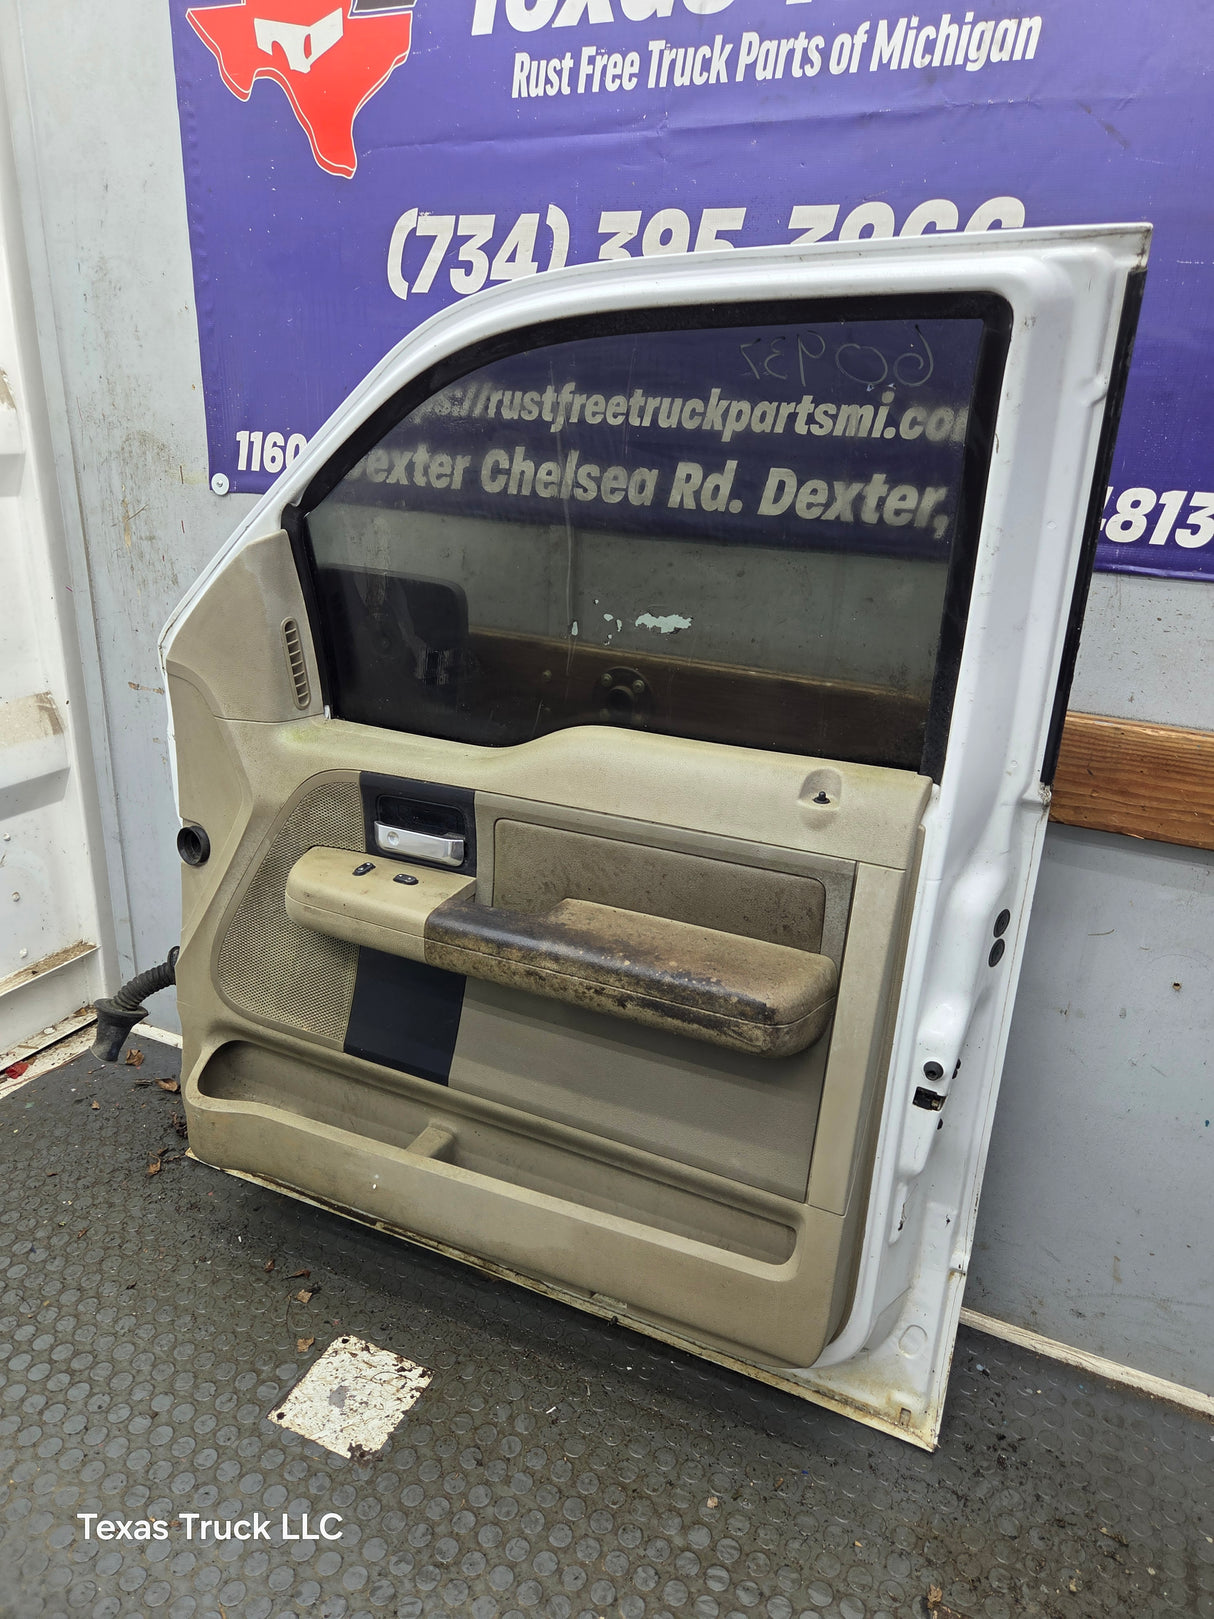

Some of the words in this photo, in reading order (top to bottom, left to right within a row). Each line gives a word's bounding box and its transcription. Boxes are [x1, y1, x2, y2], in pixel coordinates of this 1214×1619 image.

[511, 52, 573, 98] Rust
[578, 46, 640, 94] Free
[647, 34, 734, 89] Truck
[736, 31, 825, 82] Parts
[829, 21, 870, 75] of
[869, 11, 1043, 72] Michigan
[387, 204, 570, 300] (734)
[344, 443, 471, 490] exter
[481, 446, 659, 506] Chelsea
[667, 460, 743, 514] Rd.
[757, 467, 950, 540] Dexter,
[1100, 486, 1214, 548] 813
